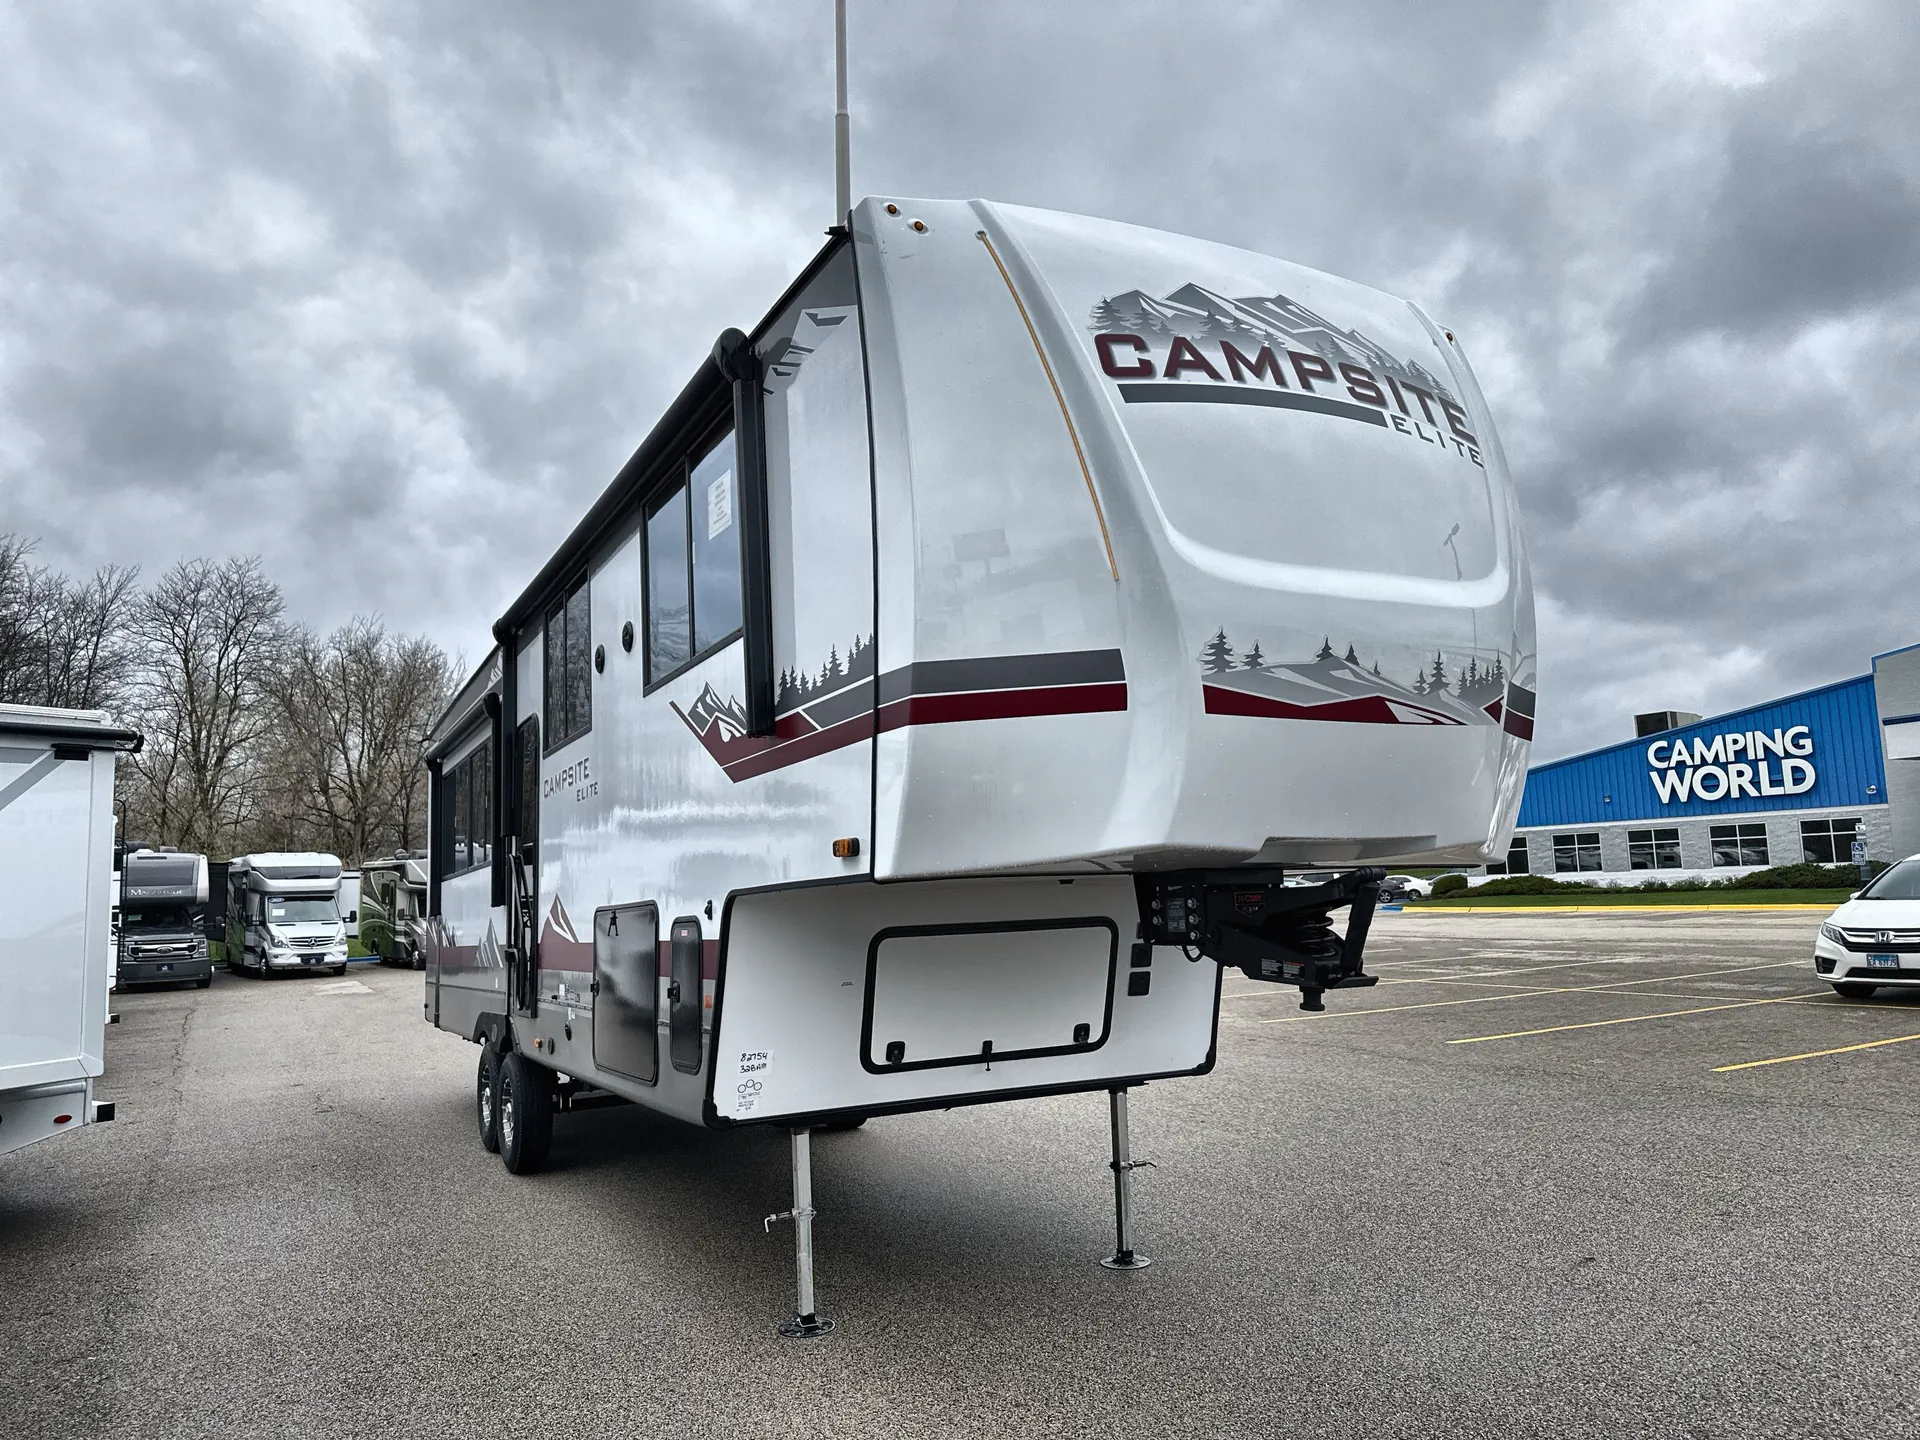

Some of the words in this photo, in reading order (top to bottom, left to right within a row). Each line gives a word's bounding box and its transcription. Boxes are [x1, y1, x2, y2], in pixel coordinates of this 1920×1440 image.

[1093, 333, 1479, 448] CAMPSITE
[1390, 414, 1484, 469] ELITE
[1647, 725, 1813, 769] CAMPING
[543, 757, 590, 799] CAMPSITE
[576, 781, 599, 802] ELITE
[1649, 758, 1816, 804] WORLD
[740, 1052, 768, 1062] 82754
